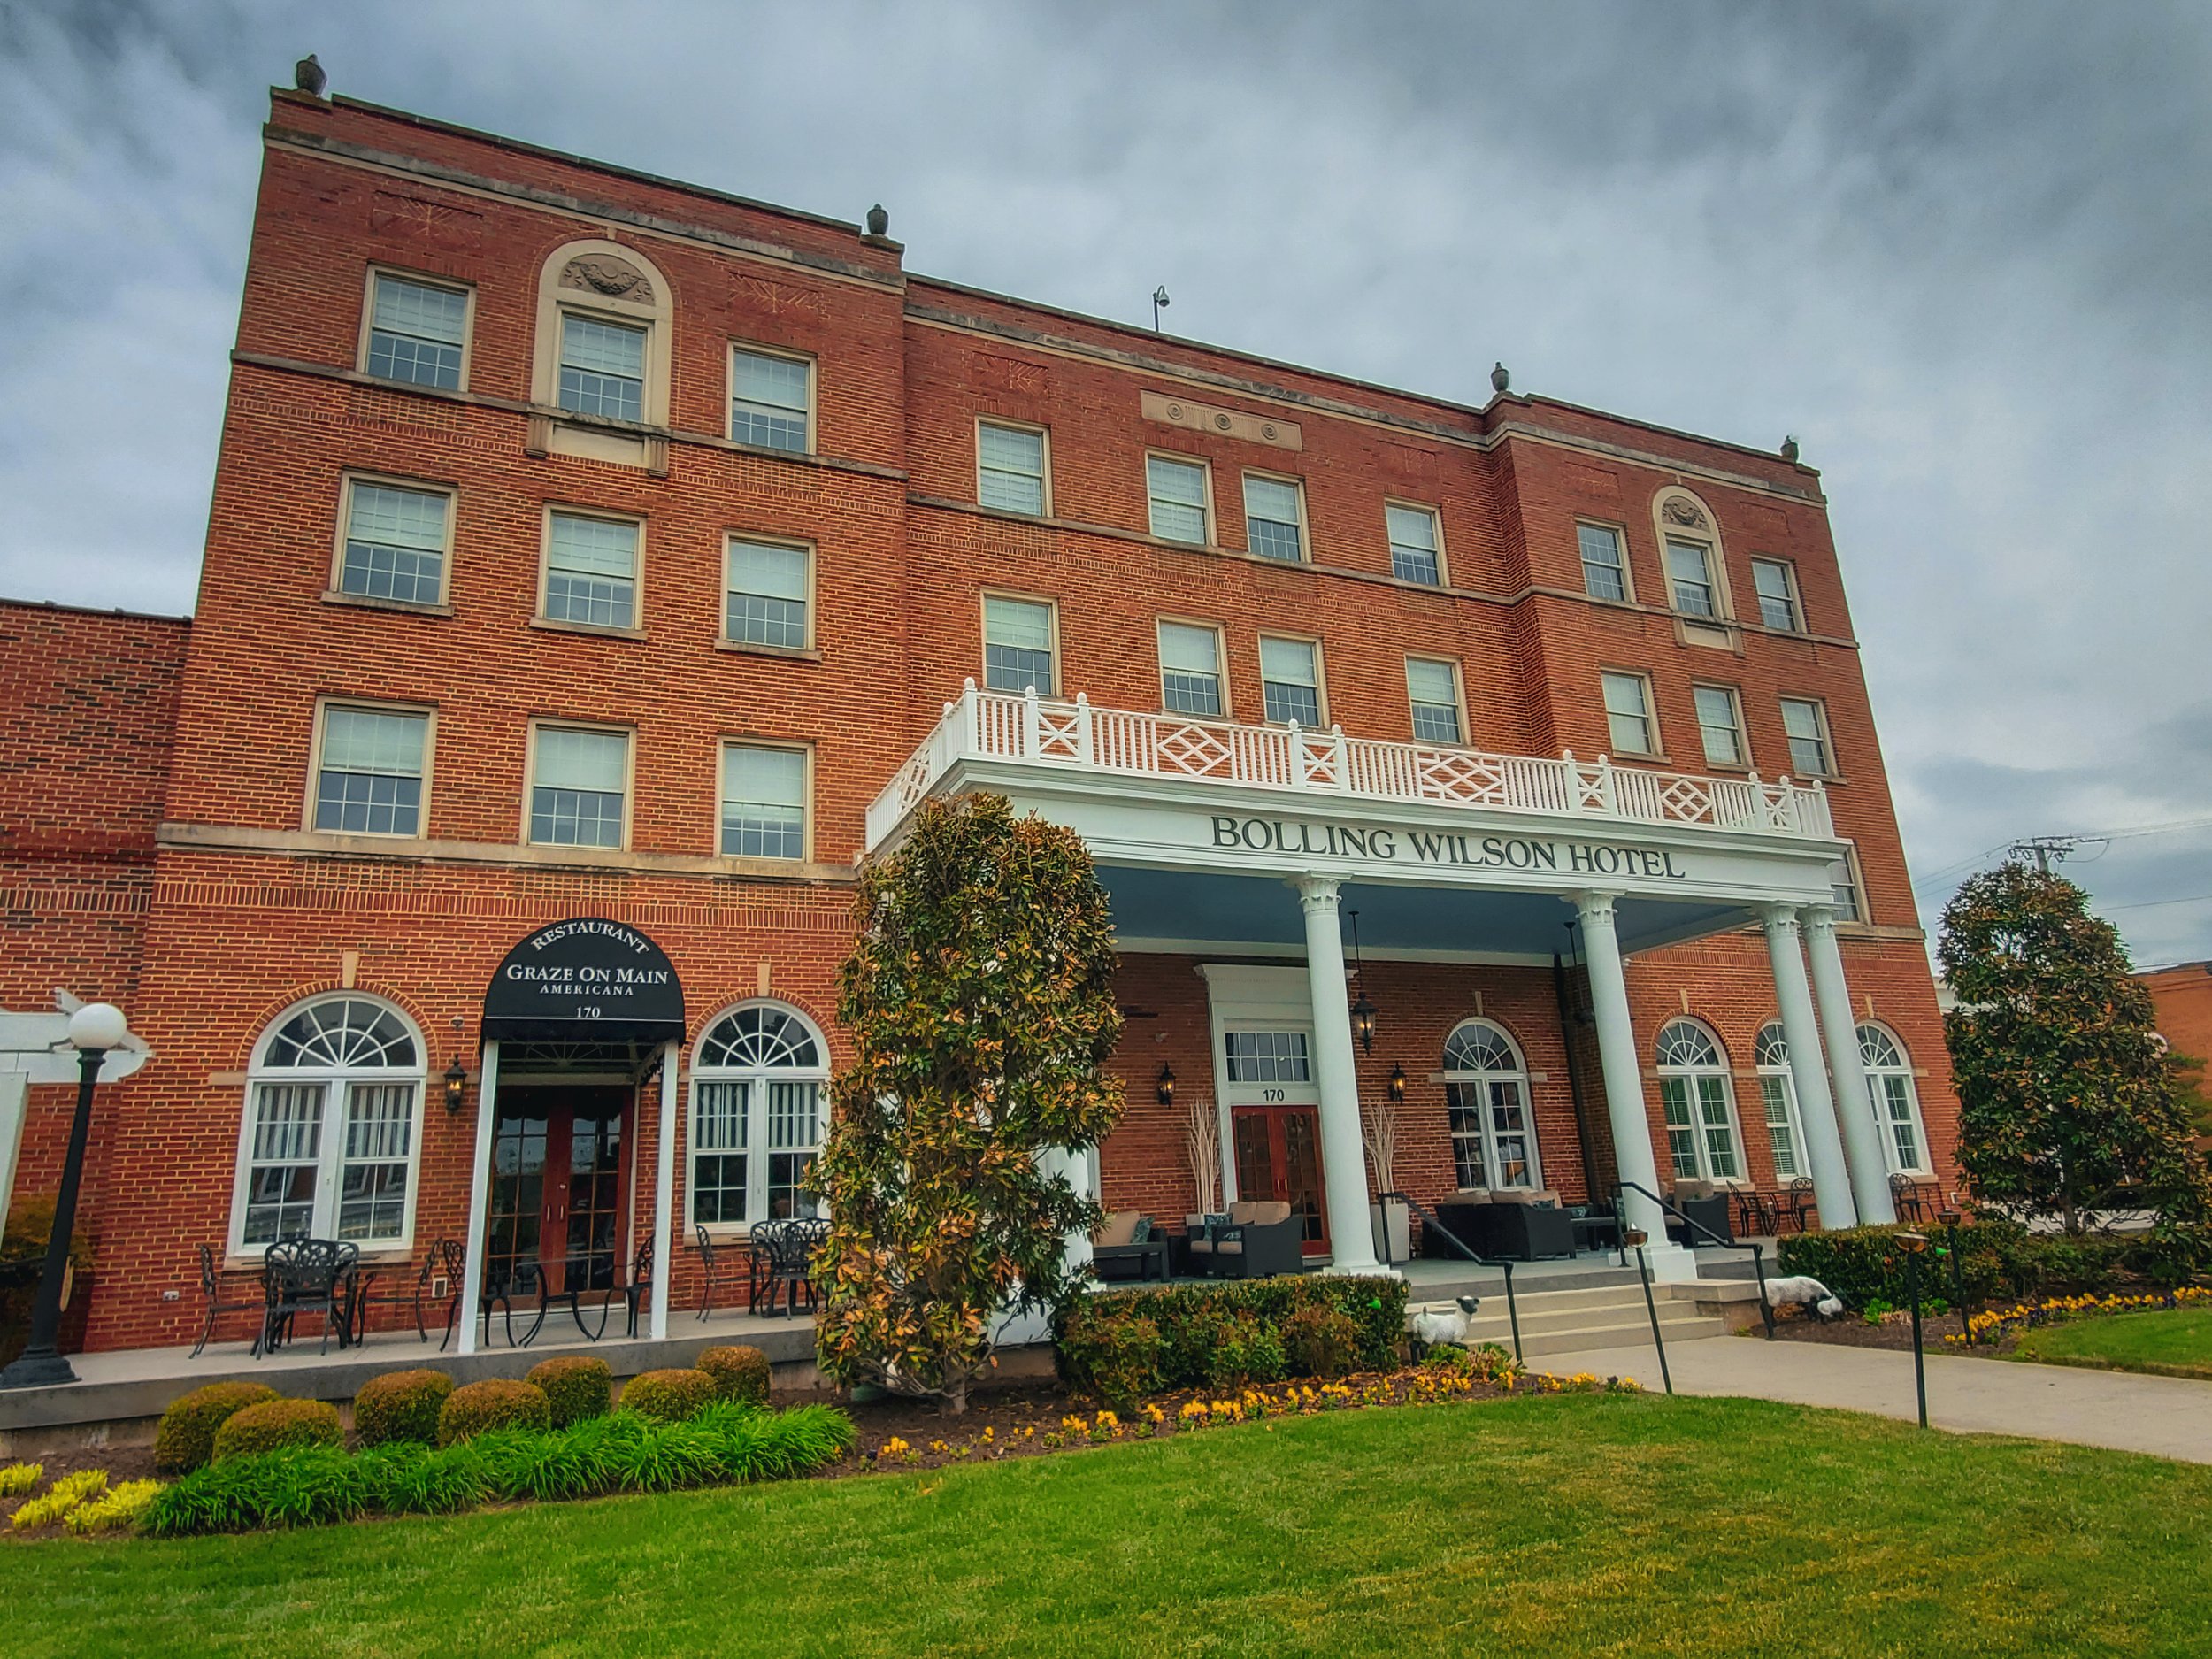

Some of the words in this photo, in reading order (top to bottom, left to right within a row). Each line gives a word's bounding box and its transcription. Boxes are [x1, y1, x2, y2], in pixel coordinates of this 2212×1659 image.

[1211, 817, 1396, 858] BOLLING
[1407, 833, 1556, 870] WILSON
[1567, 844, 1686, 878] HOTEL
[531, 921, 649, 955] RESTAURANT
[506, 964, 573, 981] GRAZE
[580, 966, 611, 982] ON
[617, 968, 669, 984] MAIN
[539, 984, 634, 996] AMERICANA
[576, 1007, 601, 1018] 170
[1263, 1089, 1285, 1102] 170
